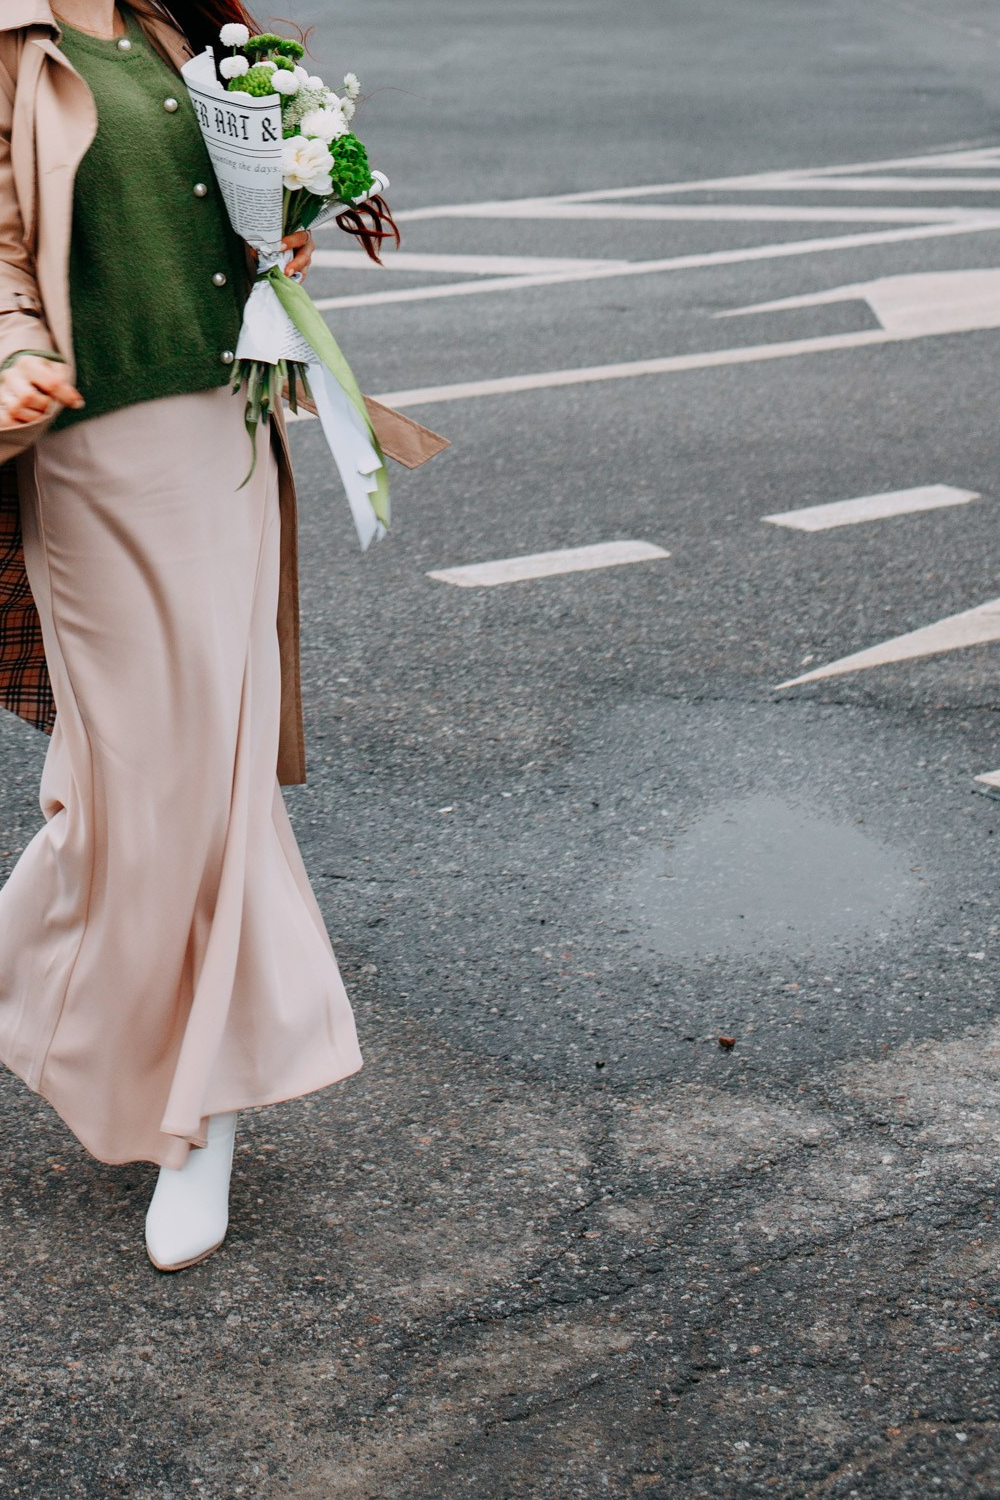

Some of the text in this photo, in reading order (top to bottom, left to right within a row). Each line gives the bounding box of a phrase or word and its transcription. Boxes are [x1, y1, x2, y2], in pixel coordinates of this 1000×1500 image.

[213, 107, 250, 140] ART
[261, 116, 278, 142] &
[239, 161, 252, 172] the
